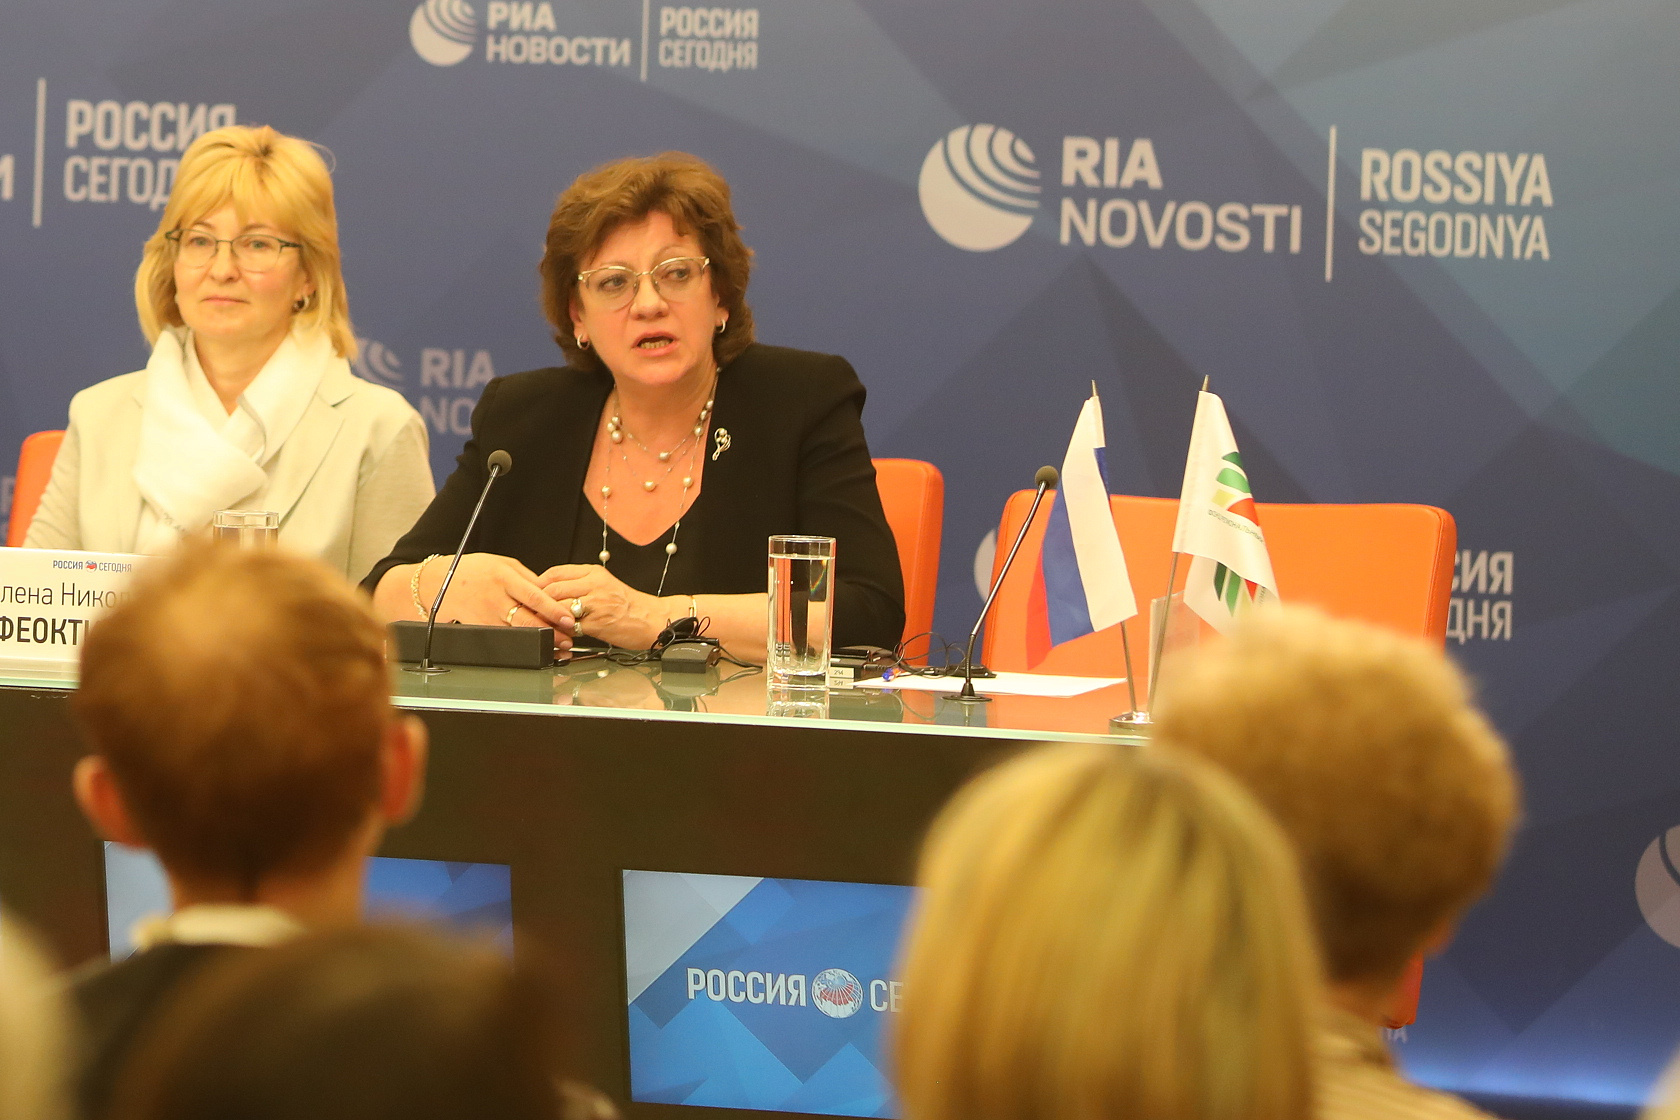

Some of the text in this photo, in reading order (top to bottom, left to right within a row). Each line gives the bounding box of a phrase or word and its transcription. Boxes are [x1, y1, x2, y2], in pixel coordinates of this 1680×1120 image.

[486, 0, 557, 32] РИА
[659, 6, 760, 39] РОССИЯ
[485, 35, 632, 67] НОВОСТИ
[658, 39, 759, 72] СЕГОДНЯ
[1060, 135, 1163, 190] RIA
[1360, 147, 1553, 207] ROSSIYA
[62, 154, 180, 212] СЕГОД
[1059, 196, 1302, 254] NOVOSTI
[1358, 208, 1551, 260] SEGODNYA
[421, 348, 496, 388] RIA
[52, 560, 132, 573] РОССИЯ СЕГОДНЯ
[686, 967, 807, 1007] РОССИЯ
